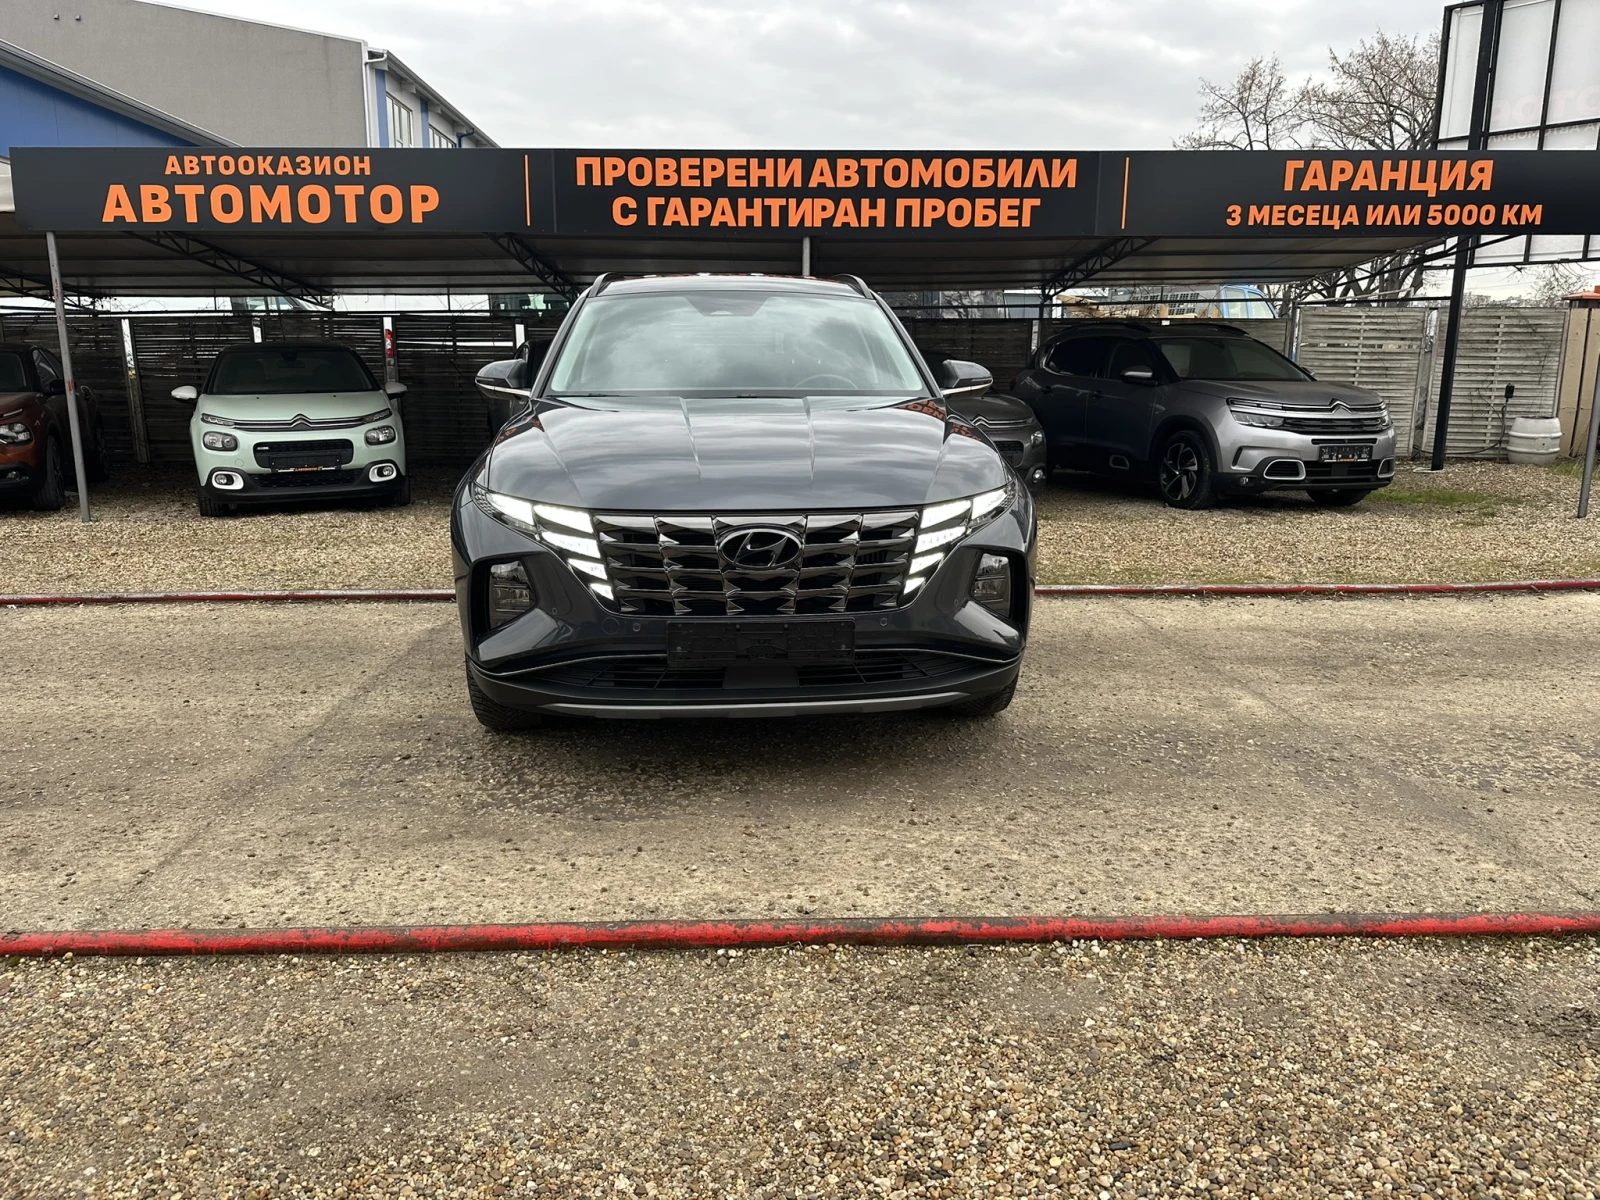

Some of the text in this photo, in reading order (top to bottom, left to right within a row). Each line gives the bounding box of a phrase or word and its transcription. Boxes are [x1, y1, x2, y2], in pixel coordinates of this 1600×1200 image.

[165, 155, 371, 176] АВТООКАЗИОН
[576, 156, 1078, 189] ПРОВЕРЕНИ АВТОМОБИЛИ
[1284, 159, 1494, 198] ГАРАНЦИЯ
[102, 184, 440, 224] АВТОМОТОР
[612, 196, 1041, 228] С ГАРАНТИРАН ПРОБЕГ
[1226, 204, 1543, 230] 3 МЕСЕЦА ИЛИ 5000 КМ
